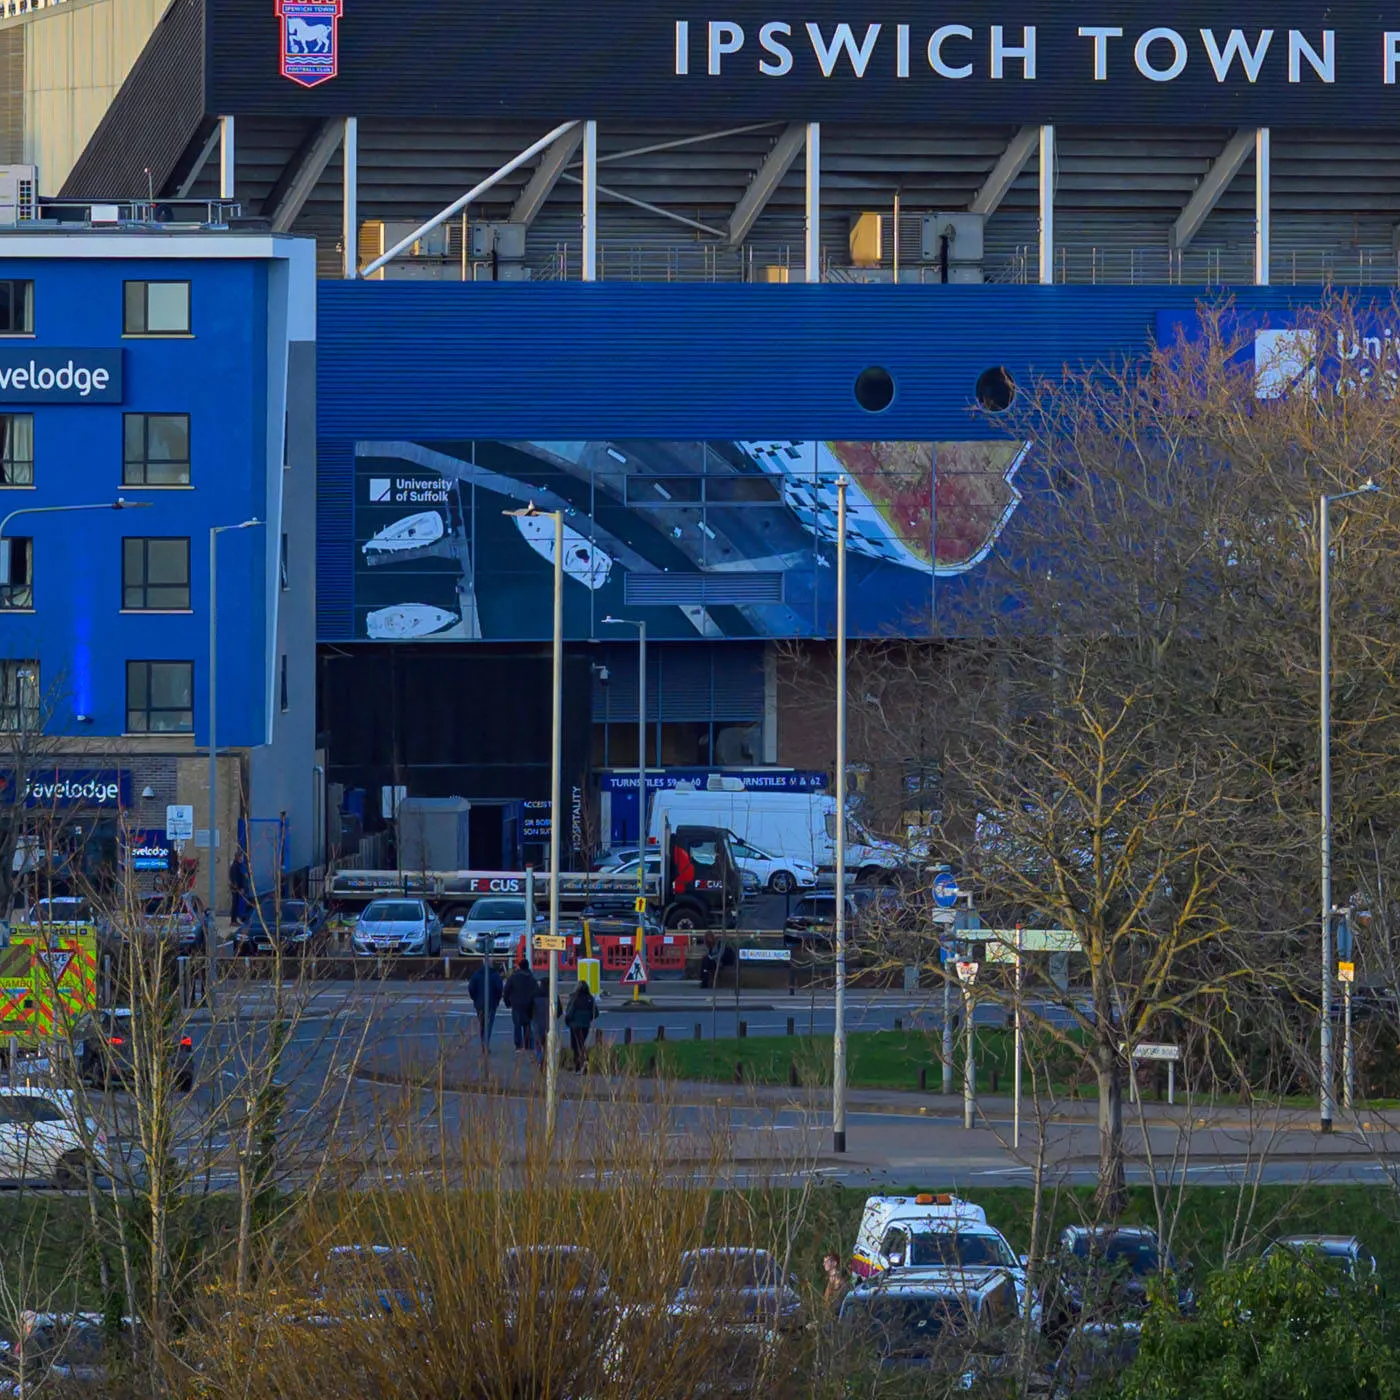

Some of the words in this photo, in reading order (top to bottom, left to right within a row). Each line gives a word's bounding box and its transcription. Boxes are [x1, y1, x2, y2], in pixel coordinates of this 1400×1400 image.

[676, 21, 1035, 79] IPSWICH
[1079, 27, 1334, 82] TOWN
[396, 478, 452, 491] University
[396, 490, 408, 501] of
[410, 490, 448, 501] Suffolk
[739, 777, 786, 786] URNSTILES
